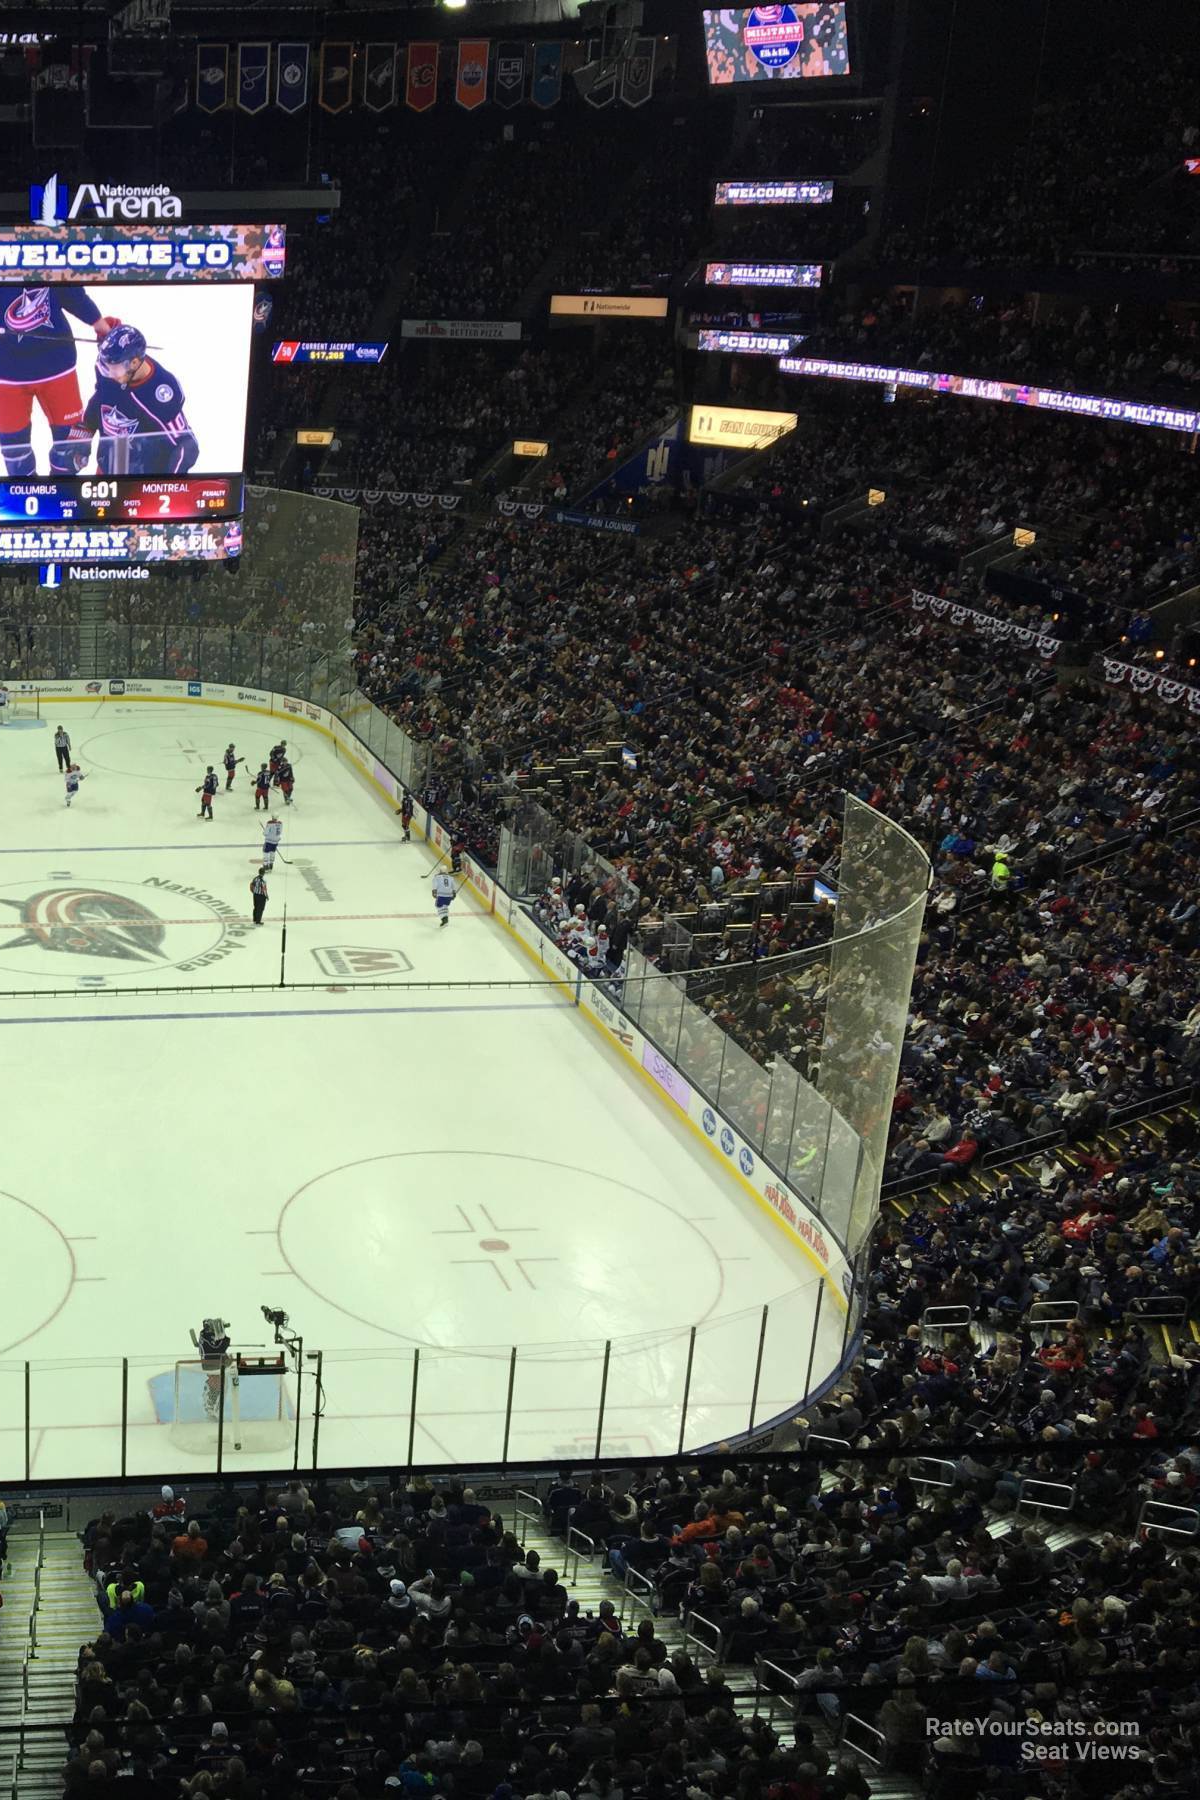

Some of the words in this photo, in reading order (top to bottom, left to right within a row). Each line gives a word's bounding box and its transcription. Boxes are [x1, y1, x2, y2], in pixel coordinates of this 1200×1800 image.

[746, 25, 801, 38] MILITARY
[100, 183, 171, 198] Nationwide
[728, 187, 796, 199] WELCOME
[800, 186, 819, 198] TO
[68, 184, 182, 221] Arena
[182, 243, 229, 265] TO
[731, 267, 794, 279] MILITARY
[719, 335, 789, 350] #CBJUSA
[804, 361, 897, 380] APPRECIATION
[899, 371, 929, 384] NIGHT
[1038, 391, 1100, 413] WELCOME
[1104, 402, 1123, 416] TO
[1124, 406, 1196, 428] MILITARY
[719, 420, 743, 434] FAN
[10, 484, 57, 494] COLUMBUS
[81, 482, 118, 498] 6:01
[142, 482, 189, 493] MONTREAL
[25, 497, 39, 516] 0
[159, 496, 171, 514] 2
[63, 509, 72, 518] 22
[97, 508, 105, 517] 2
[127, 508, 138, 517] 14
[604, 520, 637, 533] LOUNGE
[139, 536, 166, 551] Elk
[170, 536, 186, 550] &
[189, 534, 217, 551] Elk
[86, 549, 128, 559] NIGHT
[69, 566, 150, 580] Nationwide
[142, 876, 256, 937] Nationwide
[175, 939, 247, 972] Arena
